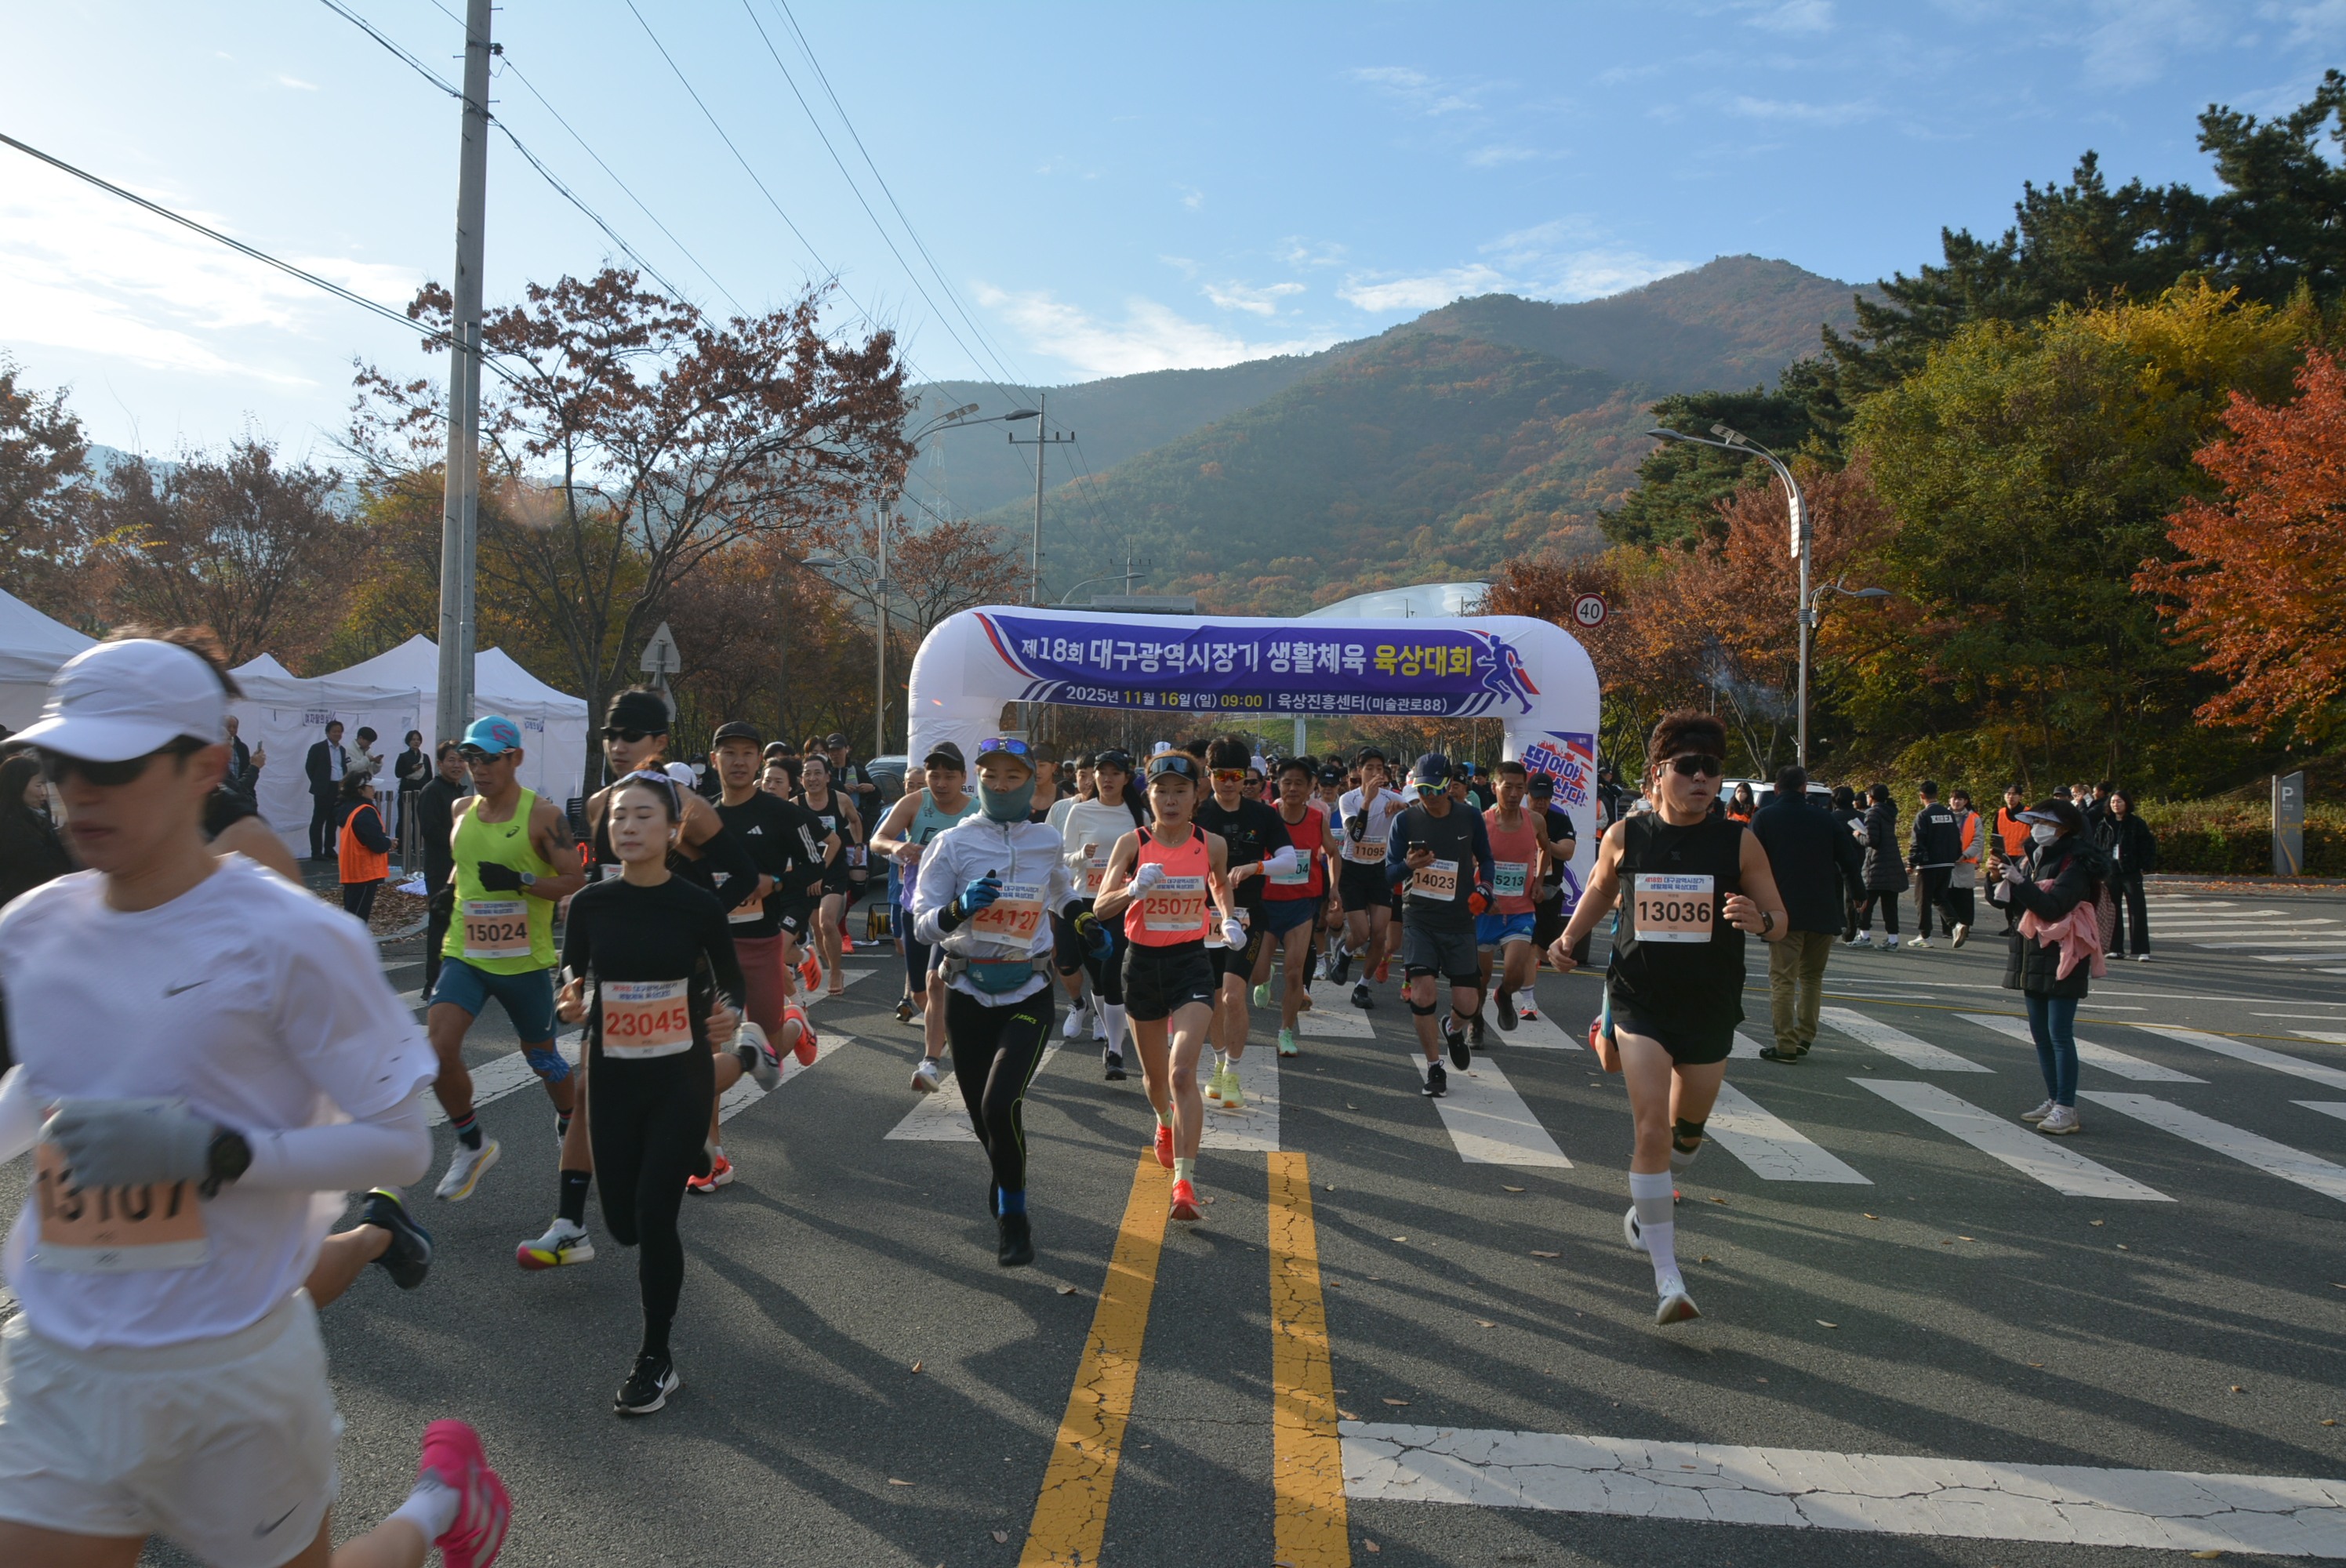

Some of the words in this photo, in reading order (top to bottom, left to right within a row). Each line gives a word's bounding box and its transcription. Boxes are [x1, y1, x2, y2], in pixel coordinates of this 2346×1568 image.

[1579, 603, 1600, 619] 40
[1021, 637, 1084, 665] 제18회
[1089, 638, 1259, 673] 대구광역시장기
[1266, 641, 1367, 676] 생활체육
[1373, 644, 1473, 677] 육상대회
[1066, 684, 1120, 703] 2025년
[1124, 690, 1155, 706] 11월
[1160, 691, 1190, 707] 16일
[1193, 692, 1217, 709] (일)
[1220, 694, 1263, 707] 09:00
[1276, 693, 1448, 713] 육상진흥센터(미술관로88)
[1522, 744, 1582, 782] 뛰어야
[2282, 786, 2293, 801] P
[1930, 814, 1953, 823] KOREA
[1355, 845, 1385, 856] 11095
[1295, 863, 1309, 875] 04
[1414, 872, 1455, 889] 14023
[1494, 875, 1525, 887] 5213
[1146, 898, 1203, 916] 25077
[1638, 901, 1711, 923] 13036
[975, 908, 1040, 931] 24127
[467, 922, 528, 942] 15024
[605, 1007, 688, 1036] 23045
